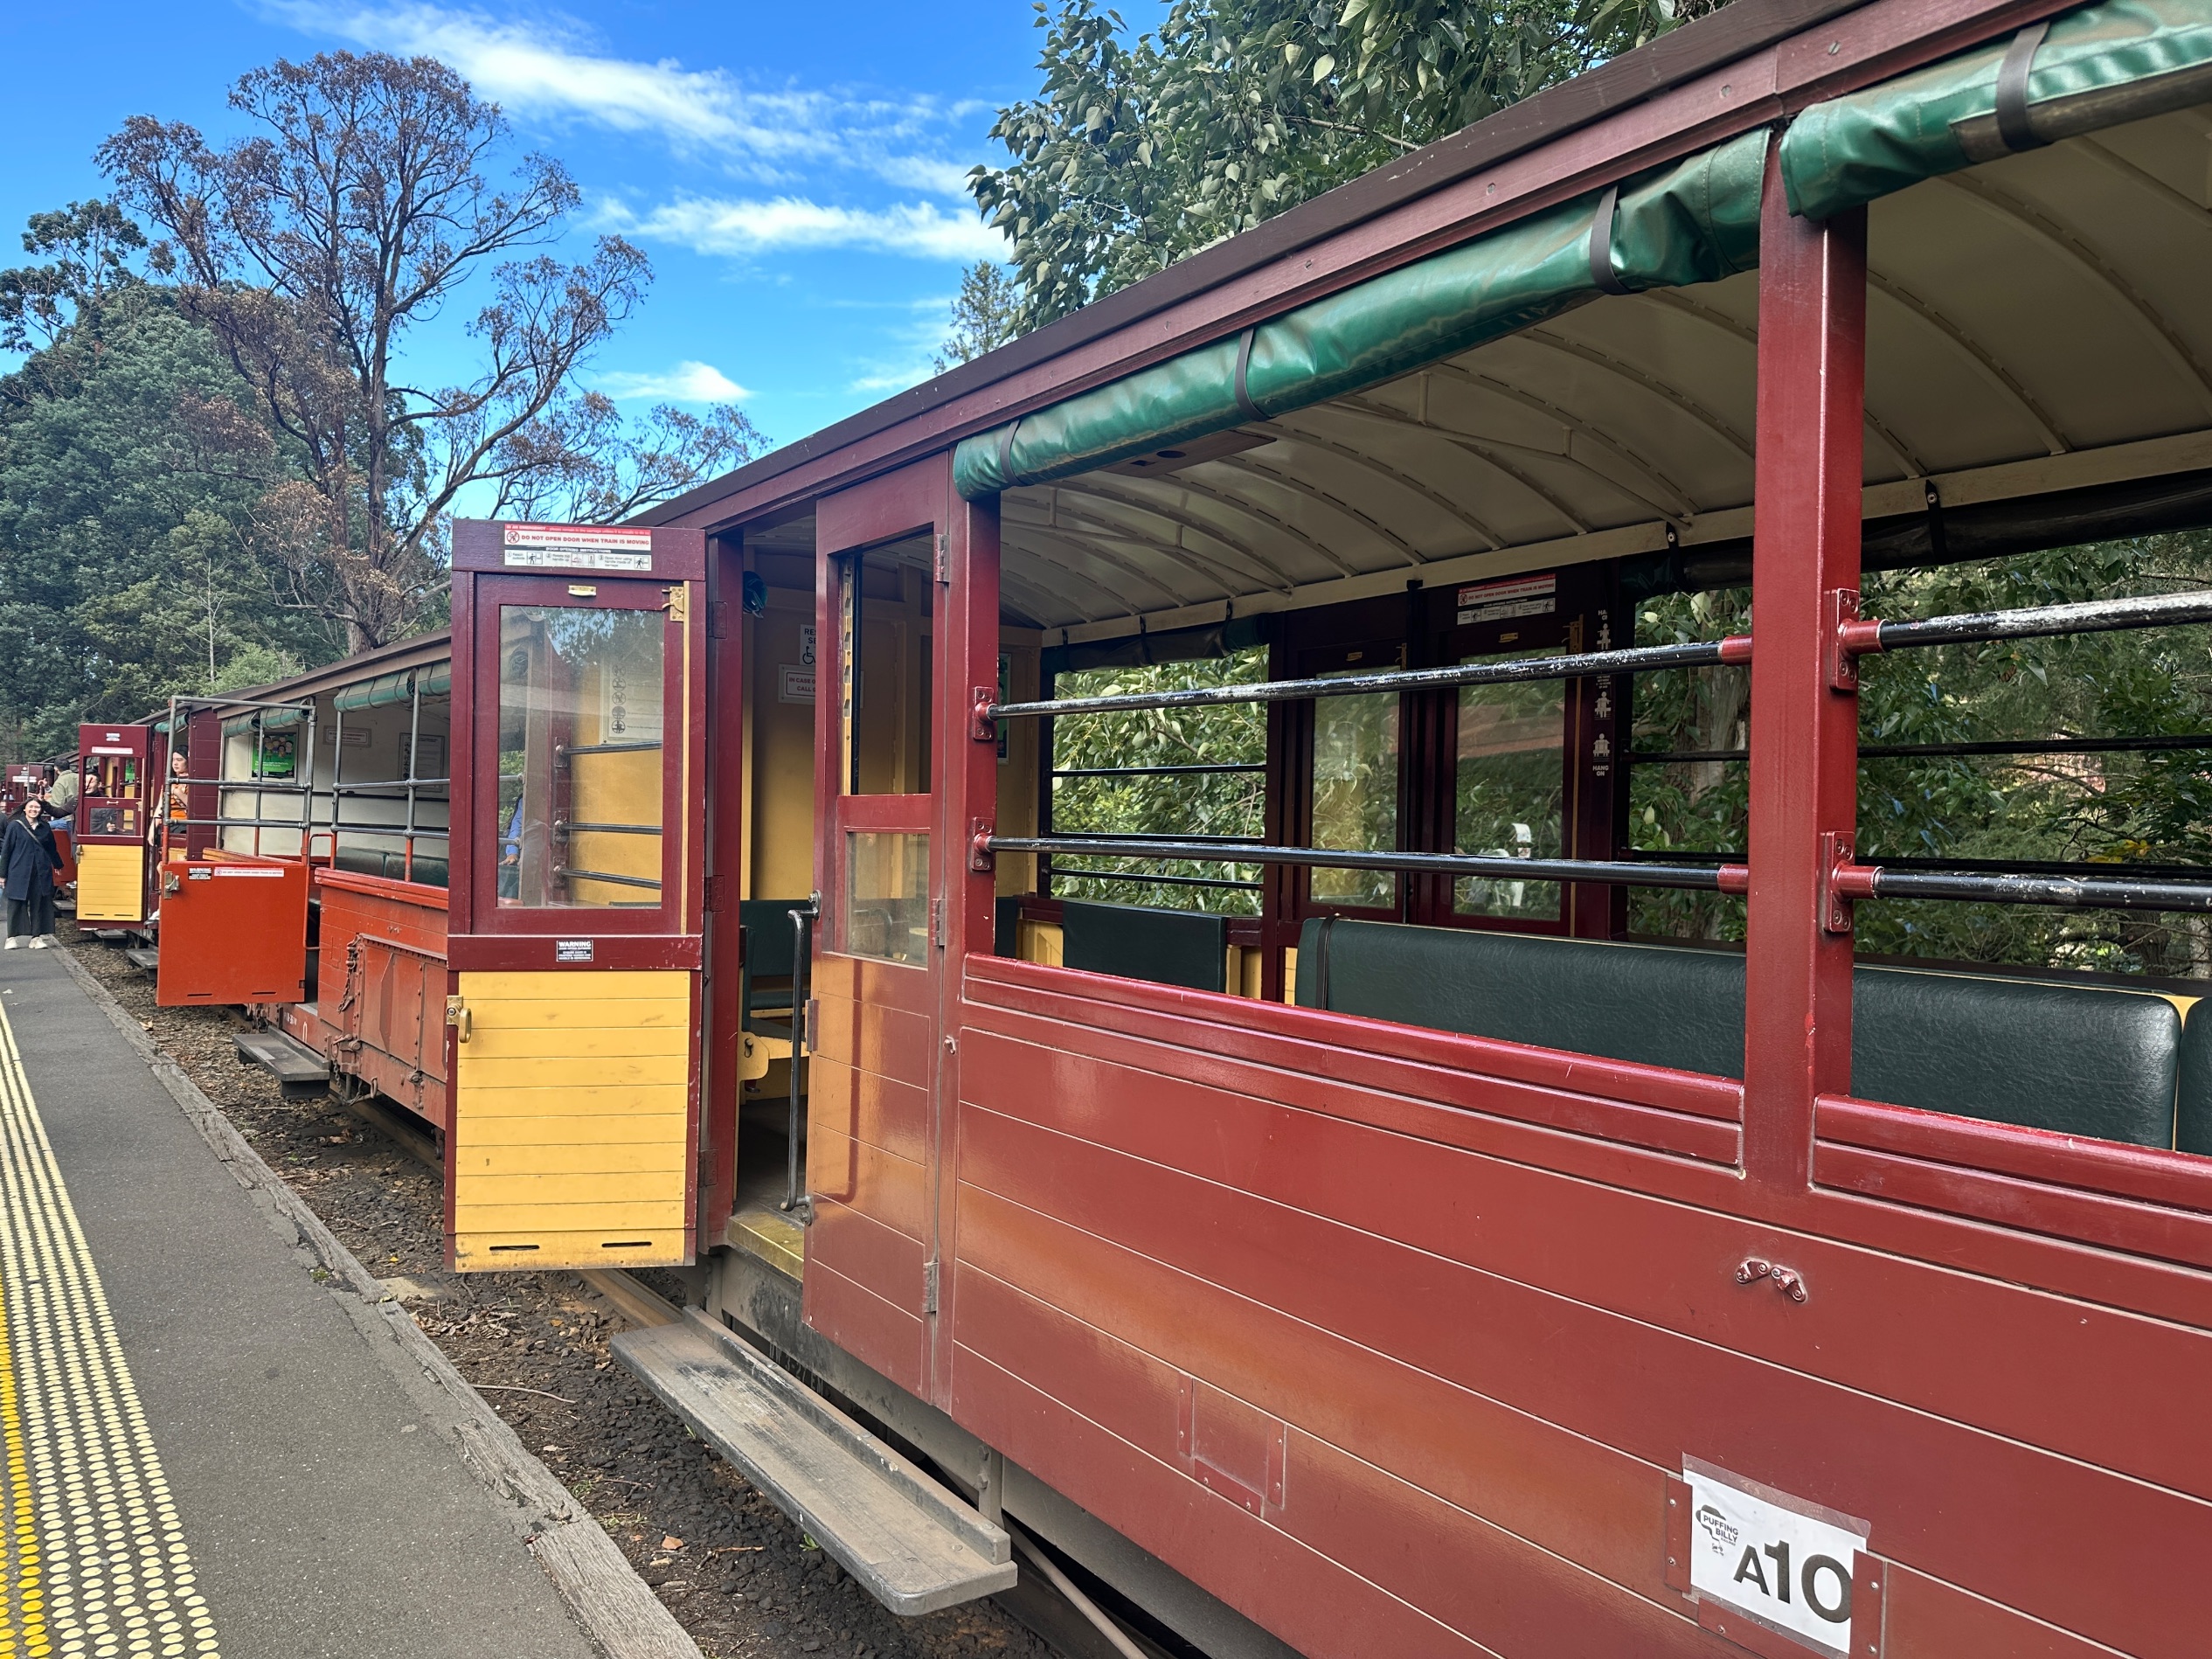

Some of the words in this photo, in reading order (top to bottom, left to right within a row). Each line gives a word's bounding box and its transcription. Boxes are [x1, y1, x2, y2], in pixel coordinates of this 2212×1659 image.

[1703, 1514, 1738, 1536] PUFFING
[1716, 1528, 1737, 1544] BILLY
[1732, 1539, 1852, 1624] A10
